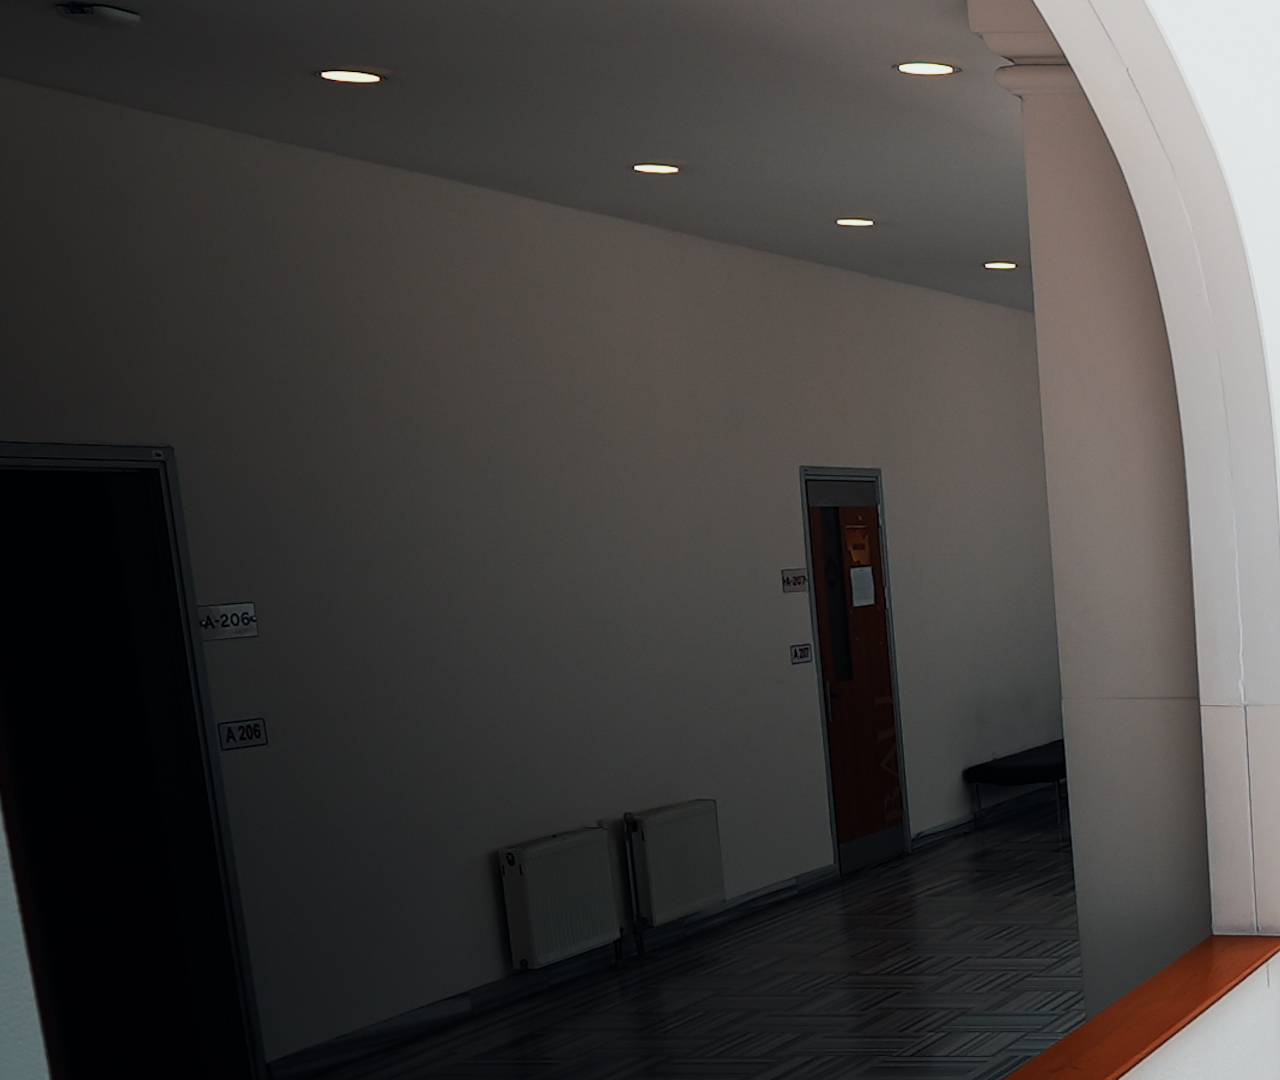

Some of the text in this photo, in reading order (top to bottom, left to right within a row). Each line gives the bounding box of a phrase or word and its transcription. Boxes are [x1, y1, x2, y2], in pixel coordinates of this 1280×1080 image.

[204, 612, 250, 629] A-206
[226, 723, 262, 743] A 206
